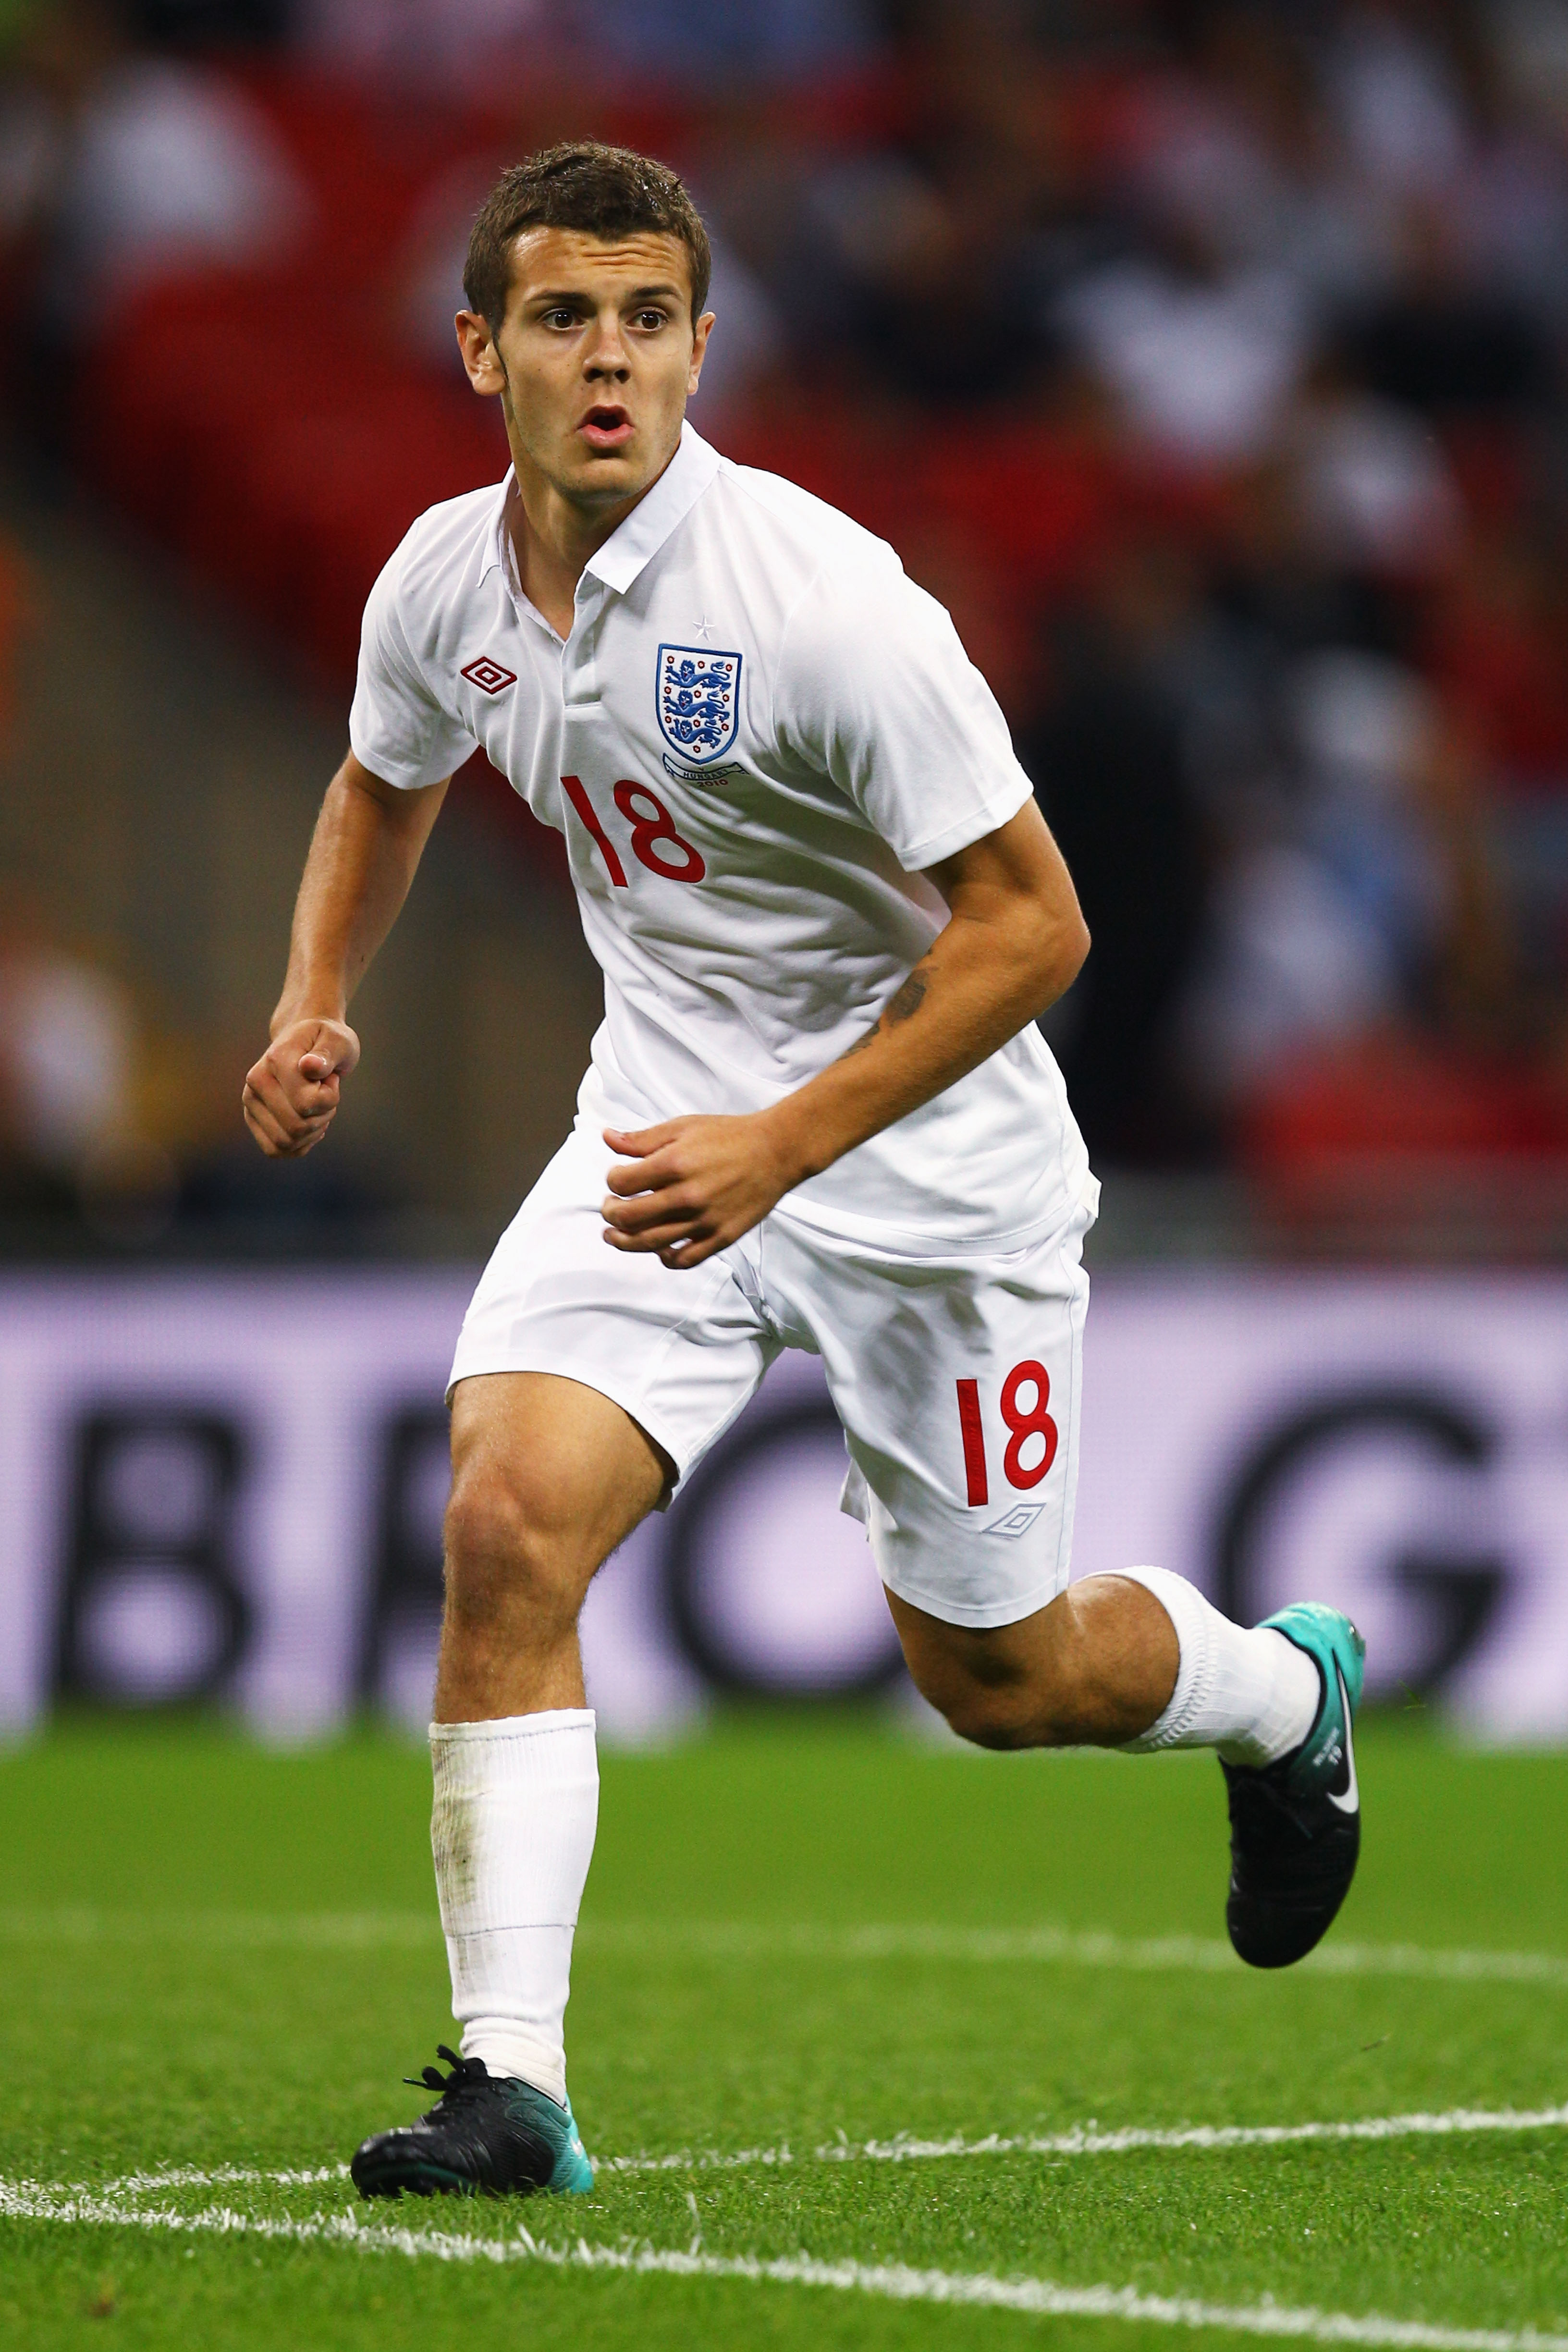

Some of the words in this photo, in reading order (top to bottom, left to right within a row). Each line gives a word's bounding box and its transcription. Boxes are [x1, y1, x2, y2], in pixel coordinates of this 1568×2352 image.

[684, 769, 728, 779] HUNGARY
[697, 779, 728, 787] 2010
[560, 775, 705, 888] 18
[956, 1360, 1058, 1507] 18
